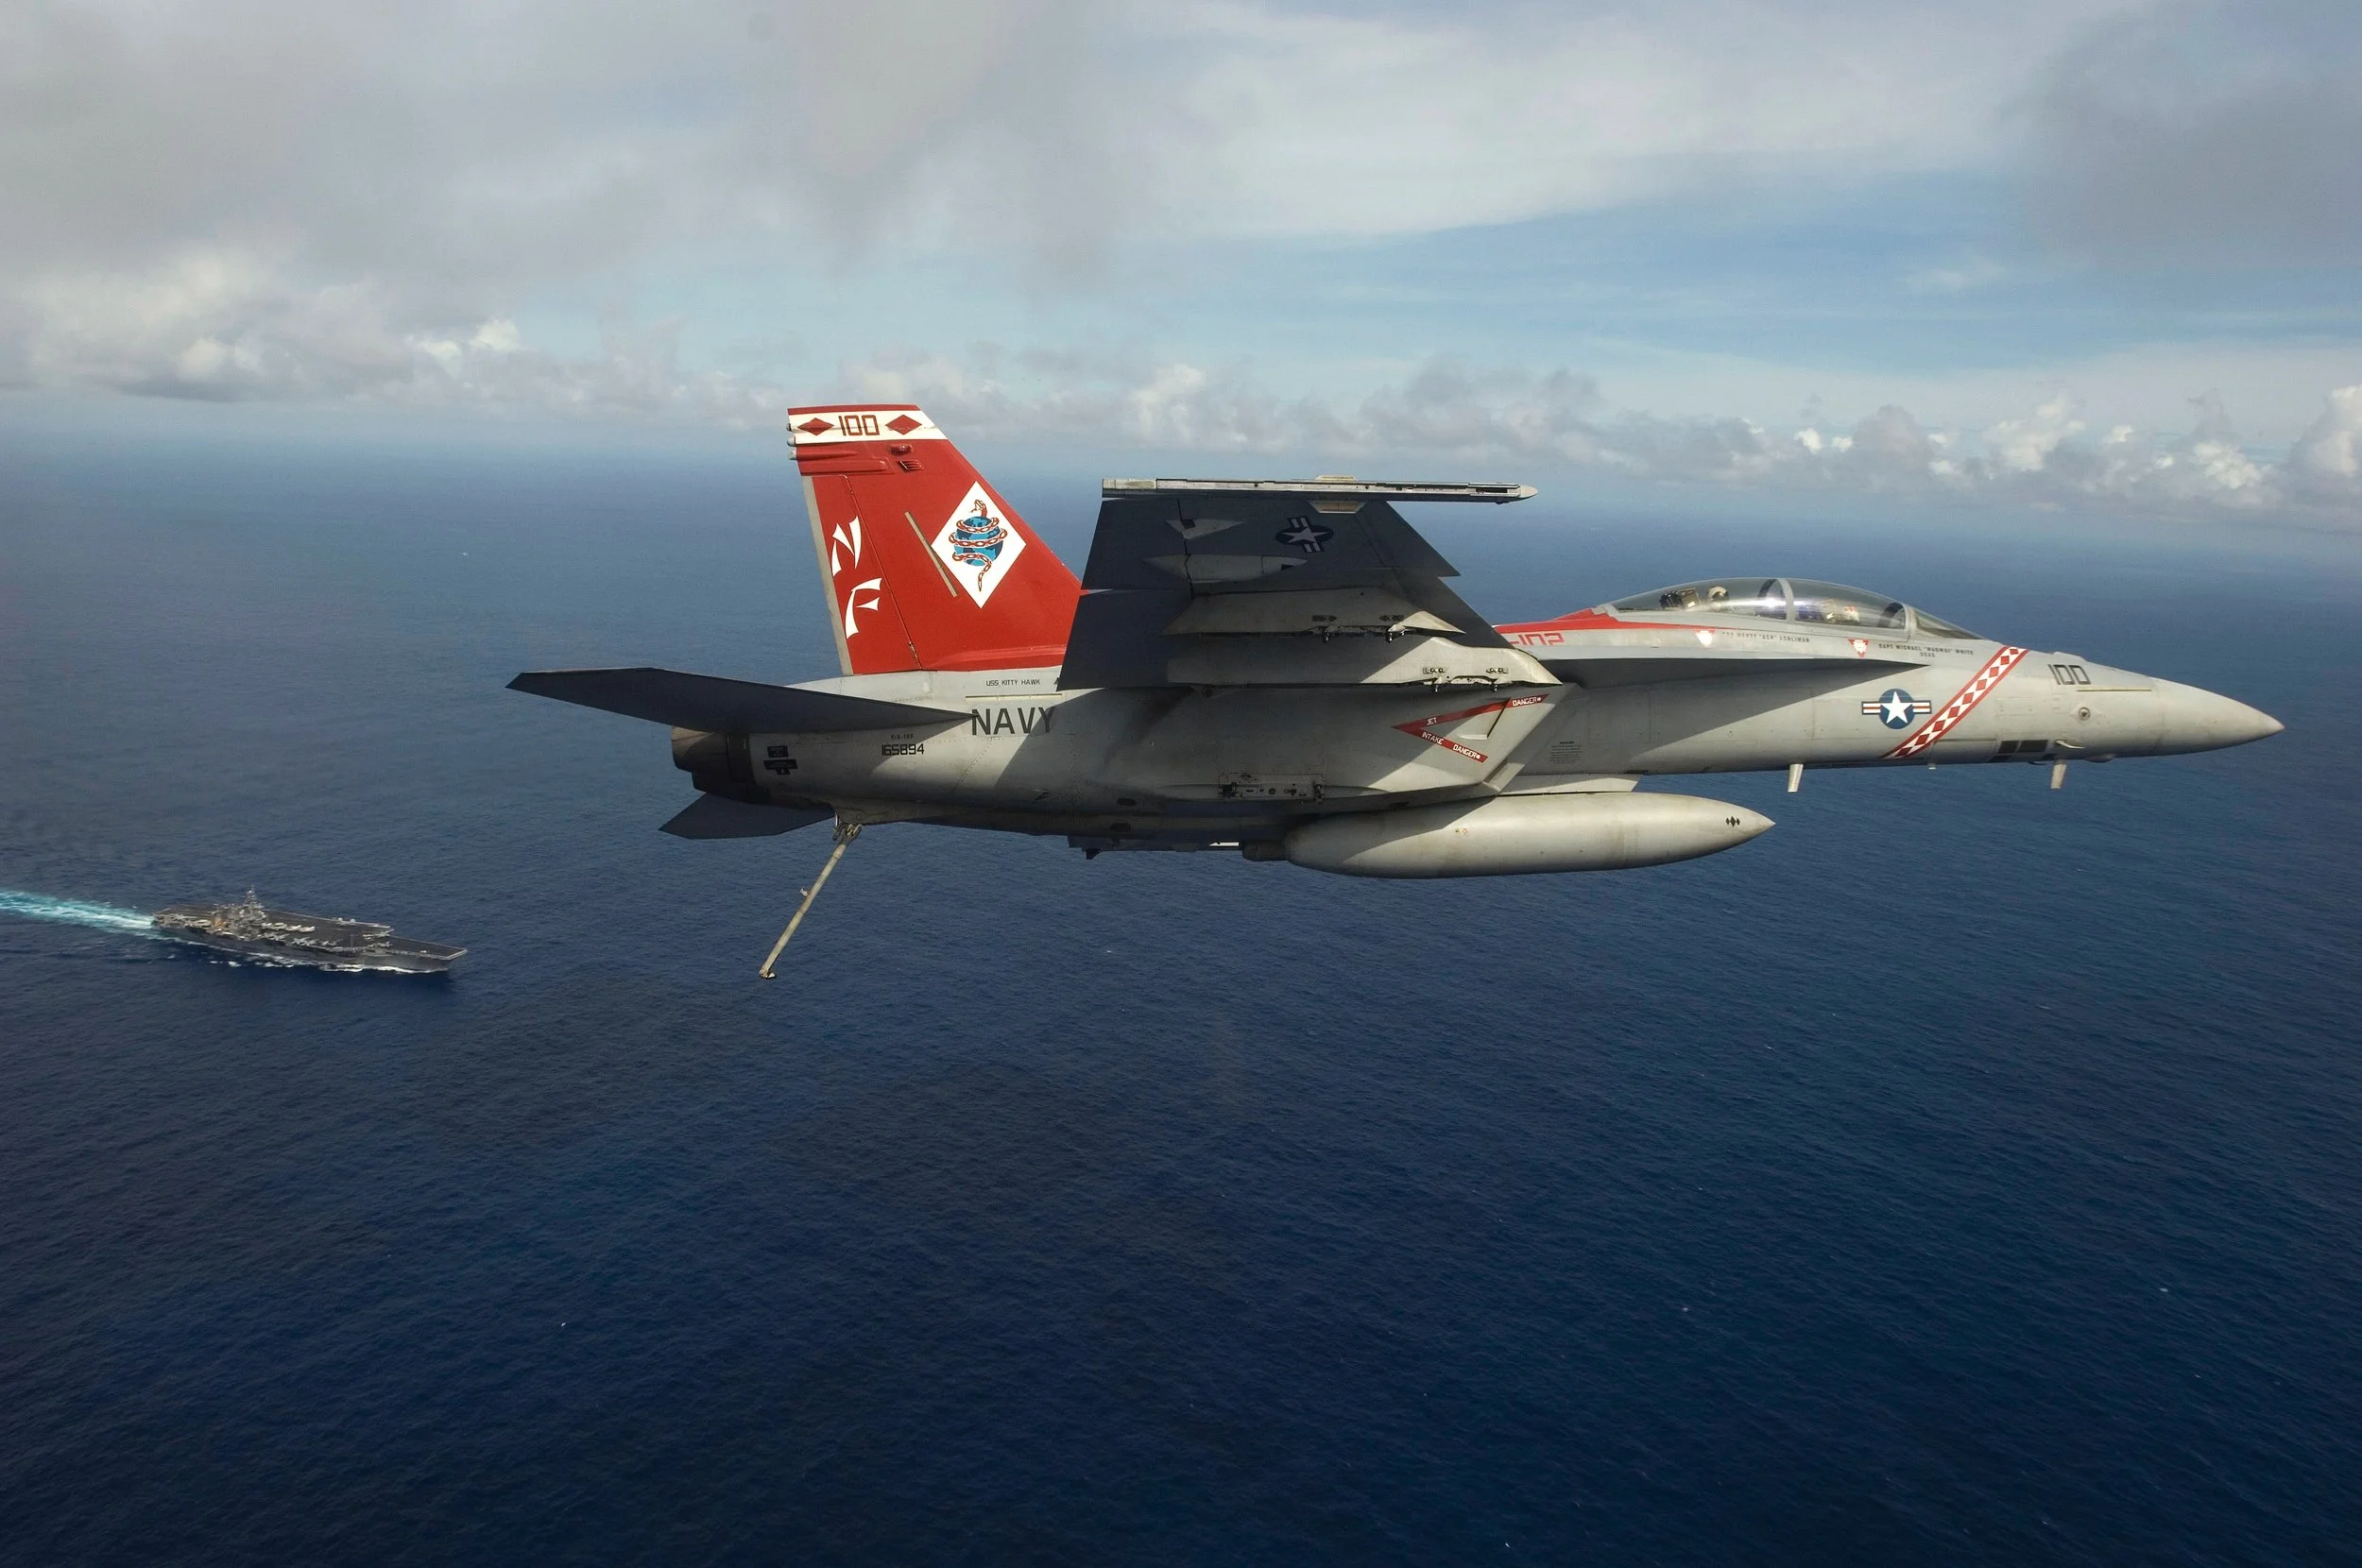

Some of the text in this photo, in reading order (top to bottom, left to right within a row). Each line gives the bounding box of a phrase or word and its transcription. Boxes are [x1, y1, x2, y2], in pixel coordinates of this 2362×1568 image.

[838, 414, 881, 436] 100
[2047, 663, 2092, 686] 100
[971, 707, 1055, 736] NAVY
[1427, 696, 1537, 726] JET DANGER
[881, 742, 925, 757] 165894
[1421, 731, 1478, 759] INTAKE DANGER
